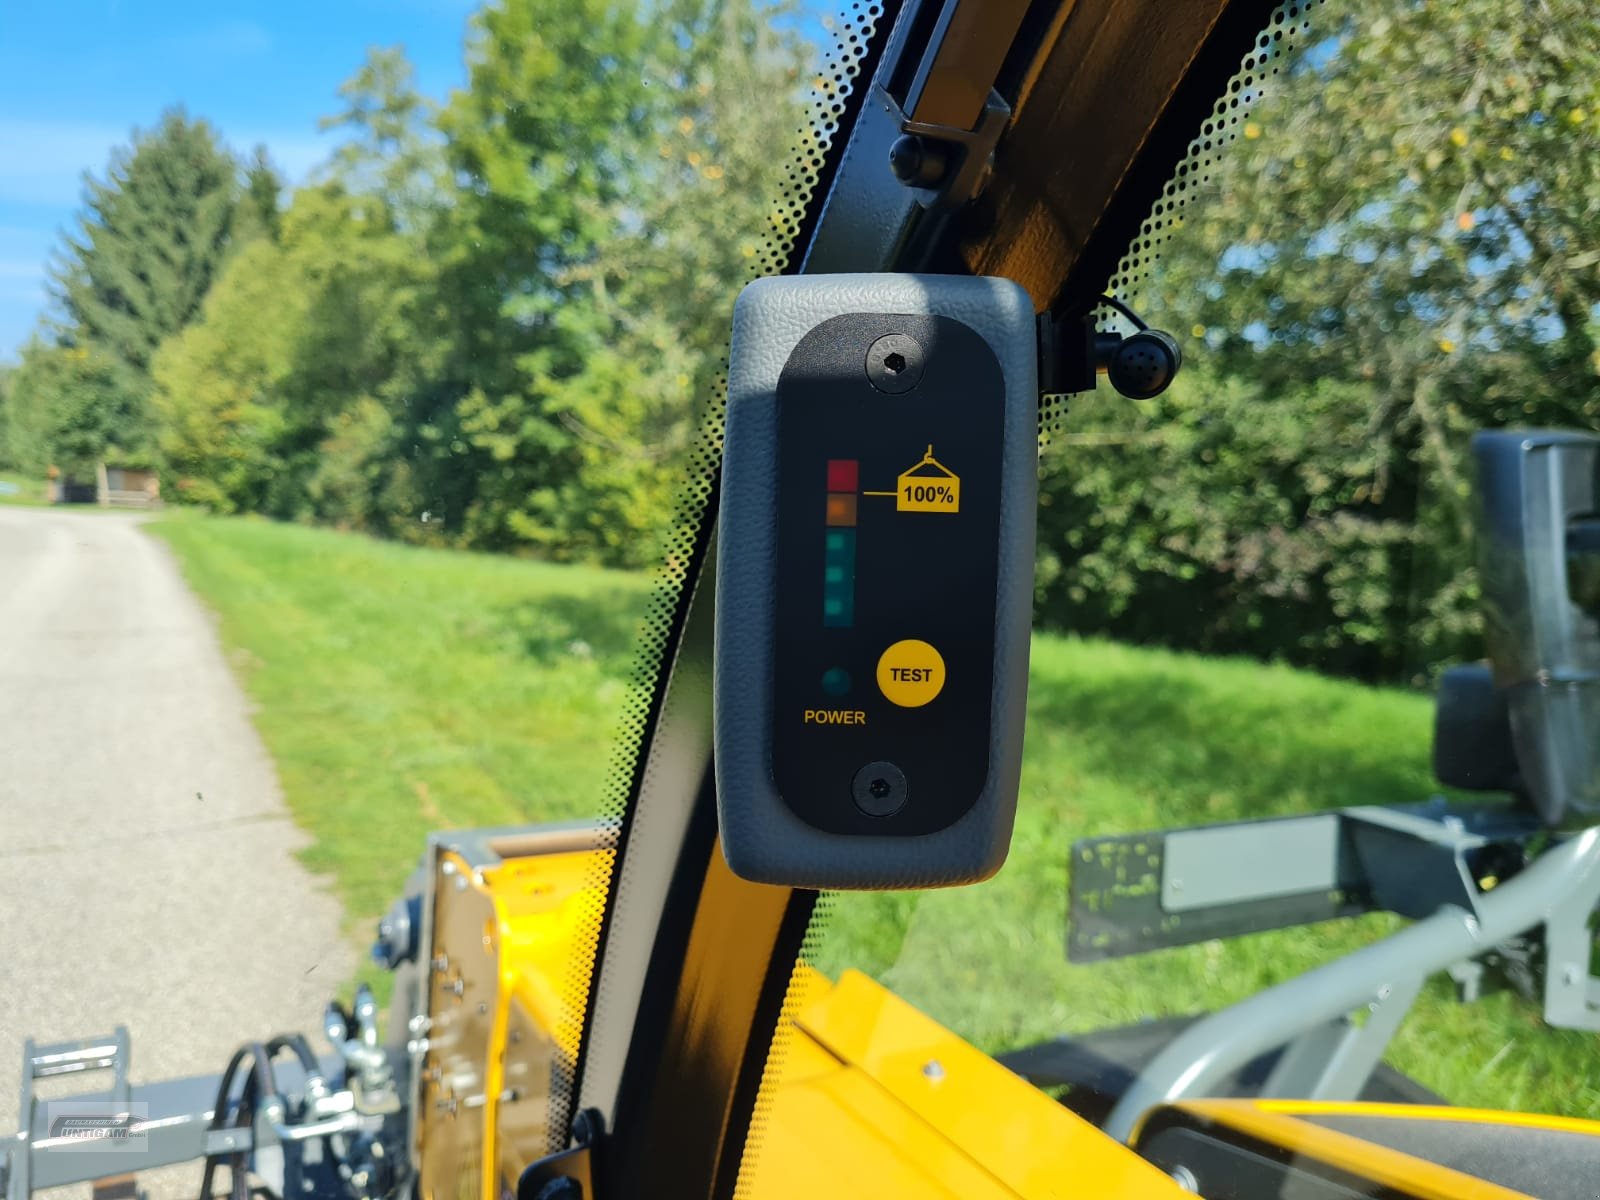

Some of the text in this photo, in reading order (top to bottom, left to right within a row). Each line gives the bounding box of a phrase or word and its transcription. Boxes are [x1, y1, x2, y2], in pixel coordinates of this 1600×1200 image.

[904, 485, 955, 505] 100%
[890, 667, 933, 683] TEST
[803, 709, 866, 726] POWER
